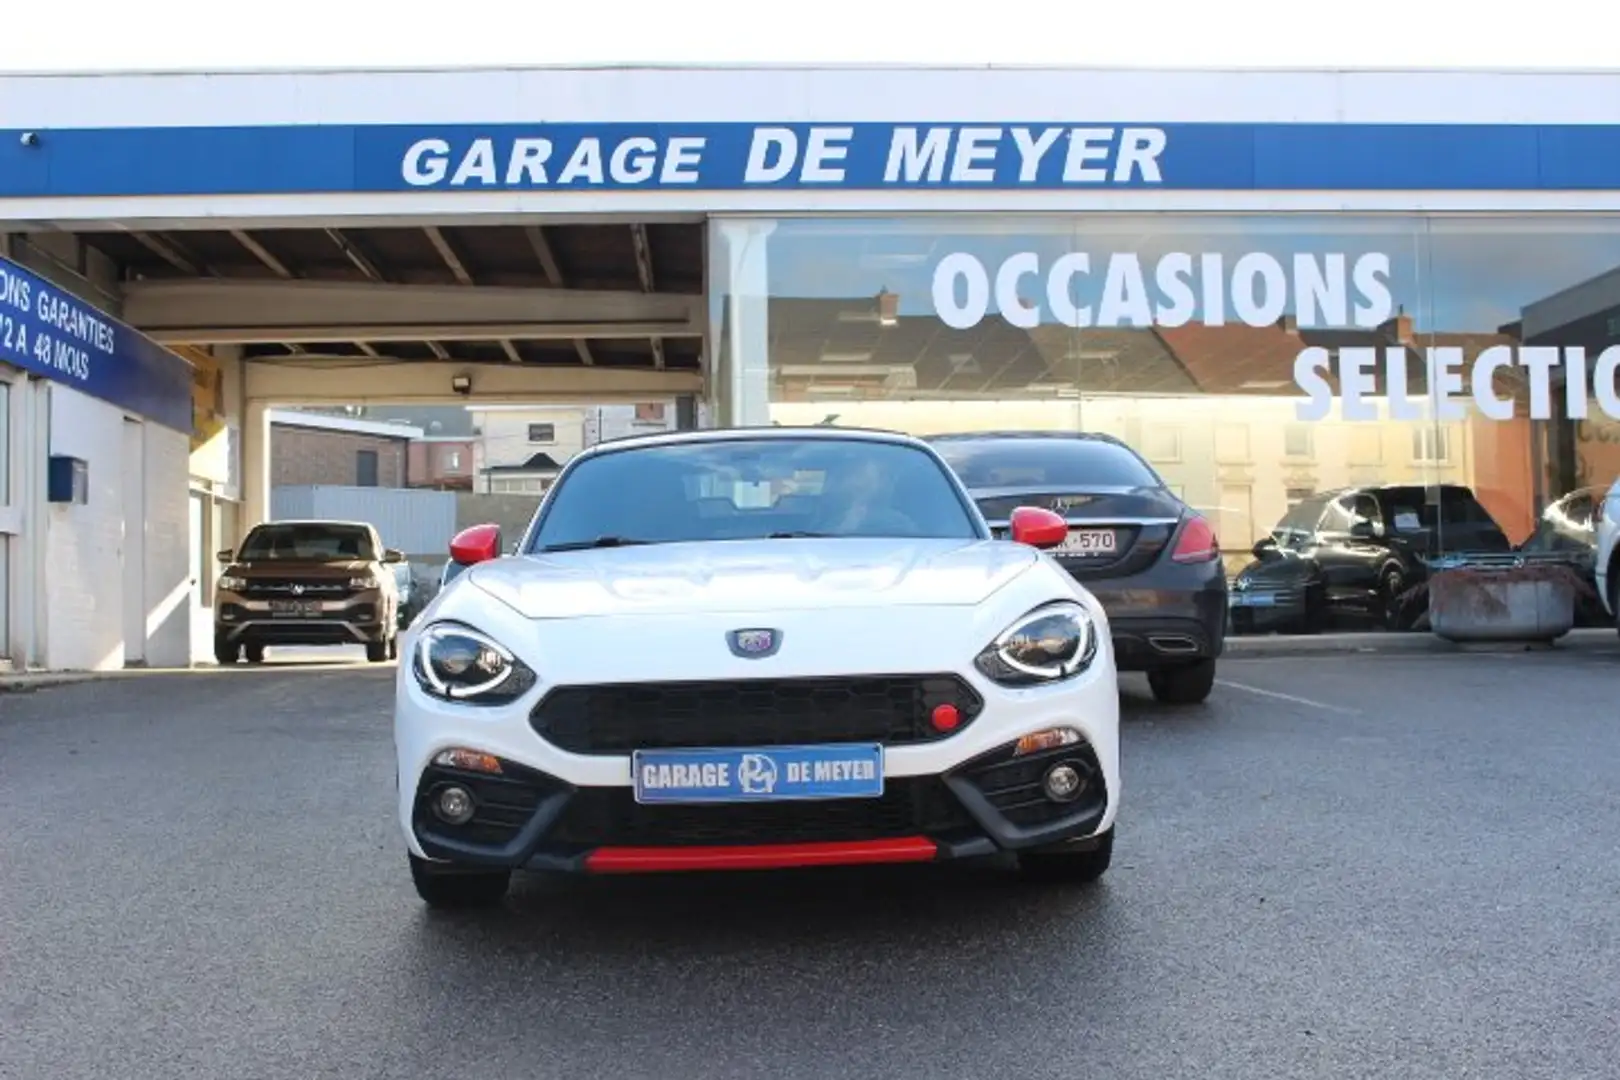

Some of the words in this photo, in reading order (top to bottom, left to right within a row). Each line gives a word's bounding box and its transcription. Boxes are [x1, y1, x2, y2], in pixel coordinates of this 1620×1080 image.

[402, 138, 706, 186] GARAGE
[744, 127, 853, 184] DE
[883, 127, 1166, 184] MEYER
[932, 251, 1394, 330] OCCASIONS
[16, 323, 28, 356] A
[33, 333, 52, 365] 48
[53, 339, 90, 381] MOIS
[37, 290, 115, 355] GARANTIES
[643, 763, 729, 788] GARAGE
[786, 761, 810, 782] DE
[814, 759, 875, 780] MEYER
